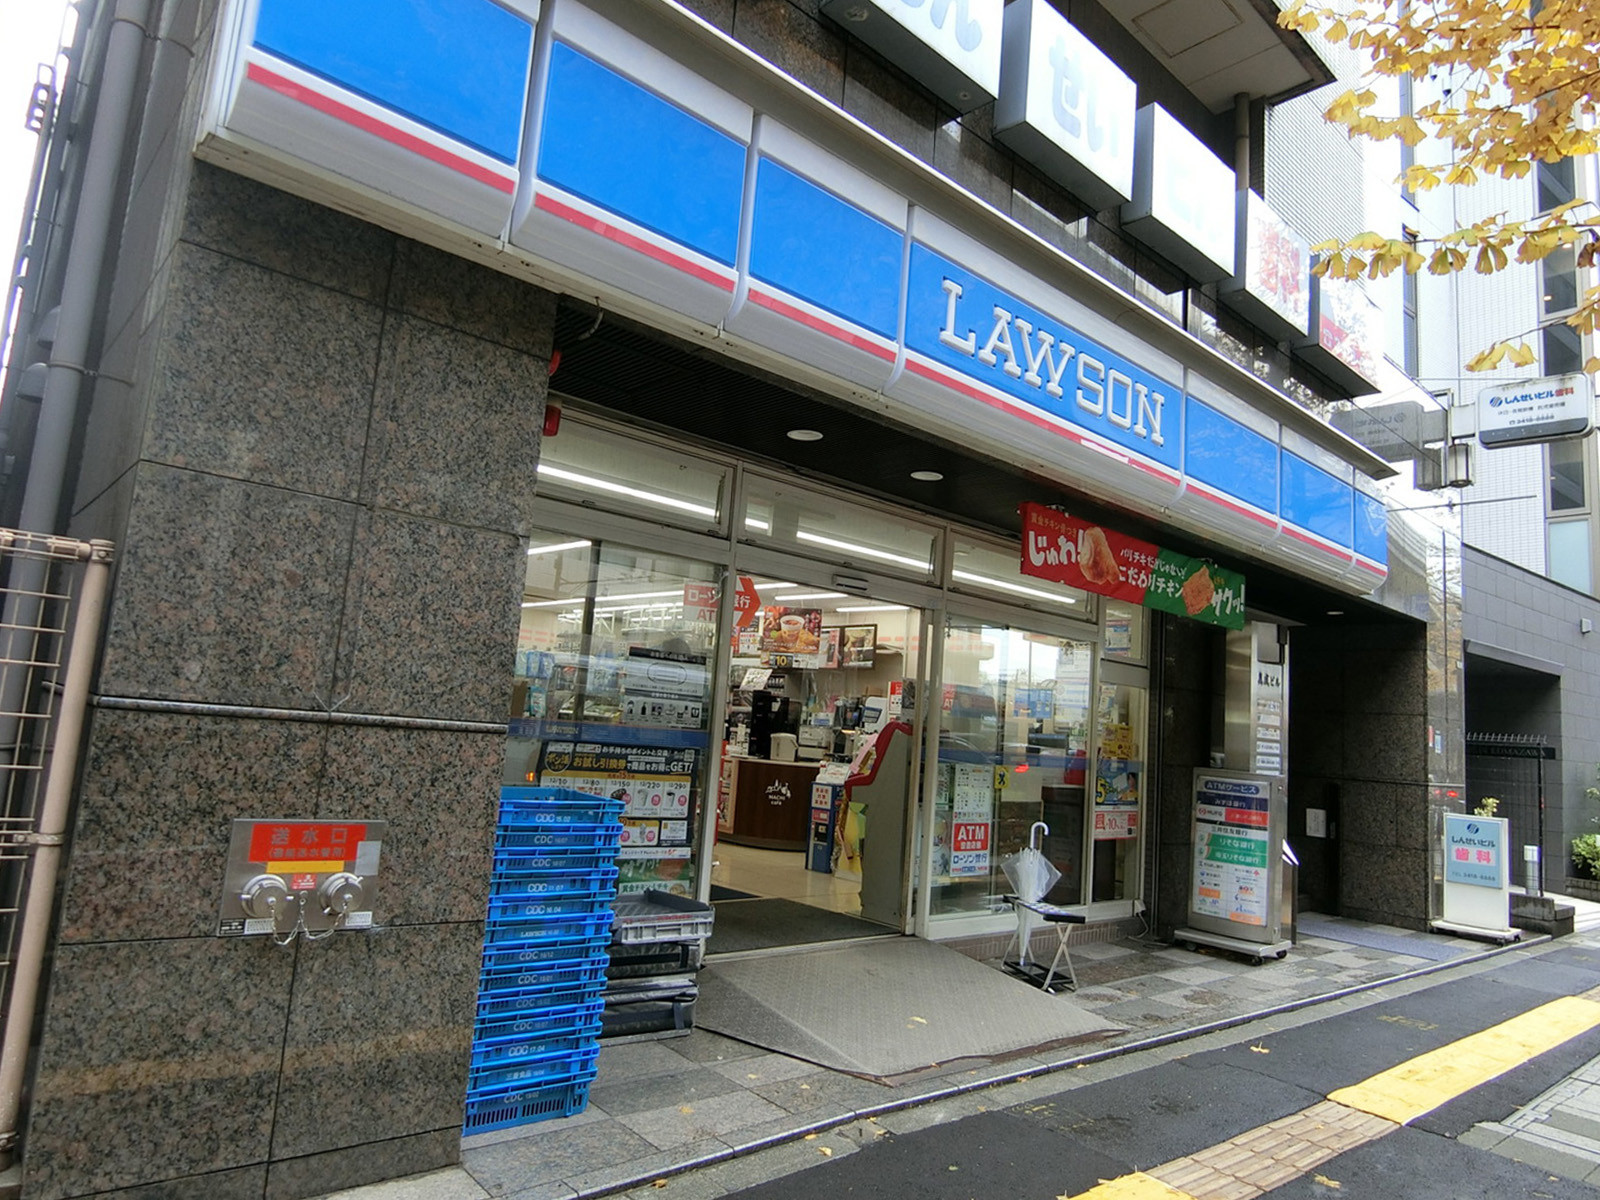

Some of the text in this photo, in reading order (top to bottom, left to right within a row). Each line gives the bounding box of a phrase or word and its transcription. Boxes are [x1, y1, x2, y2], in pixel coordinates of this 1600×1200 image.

[938, 276, 1165, 447] LAWSON
[1119, 565, 1184, 598] こだわりチキン
[271, 827, 348, 845] 送水口
[957, 825, 985, 841] ATM
[534, 835, 553, 844] CDC
[1219, 837, 1255, 850] りそな銀行
[1451, 835, 1496, 848] しんせいビル
[953, 853, 987, 864] ローソン銀行
[1455, 847, 1492, 864] 歯科
[532, 858, 551, 867] CDC
[519, 950, 539, 961] CDC
[518, 974, 538, 984] CDC
[515, 998, 536, 1008] CDC
[513, 1021, 533, 1031] CDC
[503, 1093, 523, 1104] CDC
